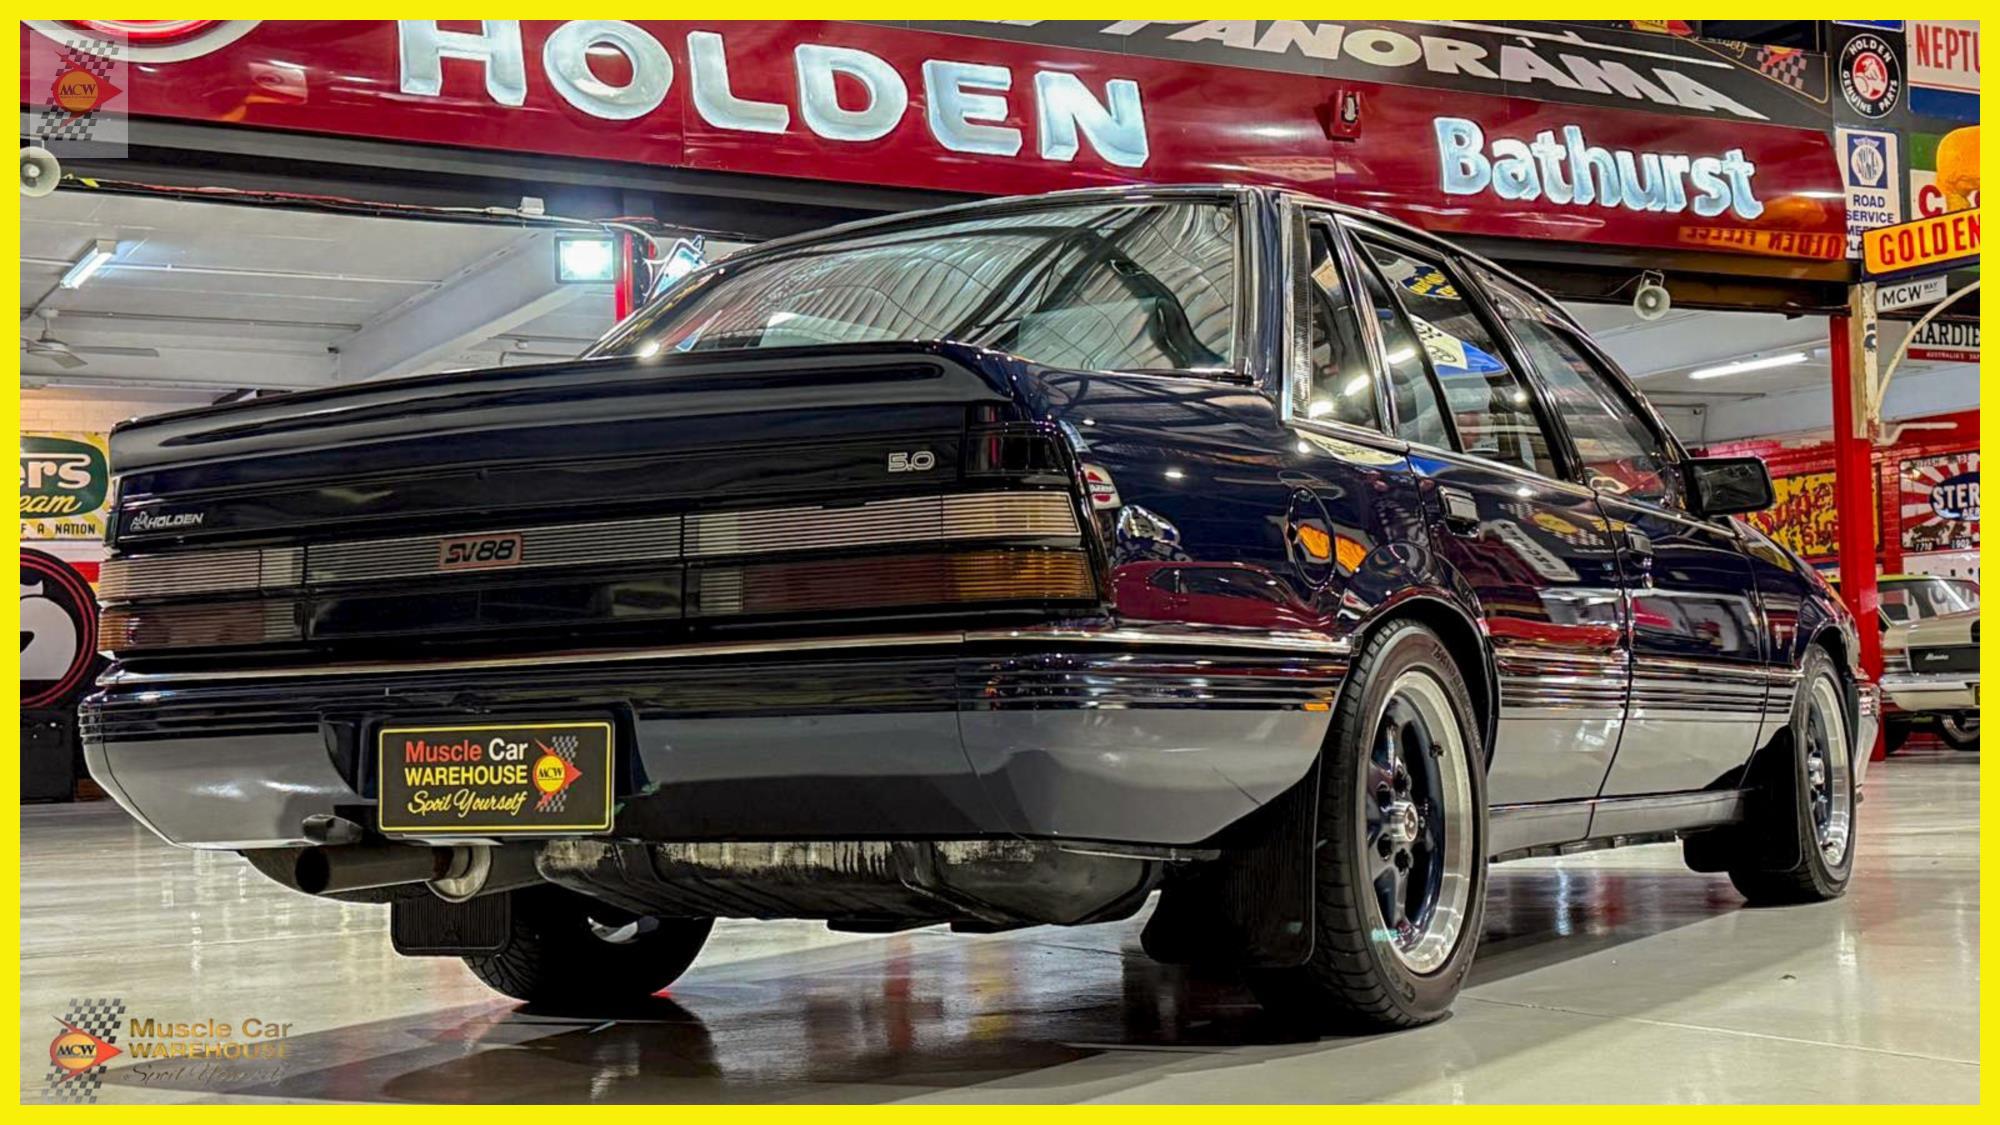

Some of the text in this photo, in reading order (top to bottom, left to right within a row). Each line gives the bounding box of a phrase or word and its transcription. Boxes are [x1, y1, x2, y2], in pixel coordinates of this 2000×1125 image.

[1849, 39, 1892, 63] HOLDEN
[397, 20, 1150, 168] HOLDEN
[1843, 71, 1898, 113] GENUINE PARTS
[1432, 116, 1765, 219] Bathurst
[1853, 194, 1886, 208] ROAD
[1845, 210, 1895, 223] SERVICE
[1879, 213, 1980, 266] GOLDEN
[1882, 282, 1938, 307] MCW WAY
[888, 451, 935, 472] 5.0
[1932, 482, 1980, 509] STER
[37, 524, 45, 534] A
[55, 523, 96, 535] NATION
[147, 512, 205, 529] HOLDEN
[444, 539, 517, 564] SV88
[405, 738, 529, 763] Muscle Car
[404, 765, 528, 786] WAREHOUSE
[538, 768, 564, 779] MCW
[407, 788, 528, 818] Spoil Yourself
